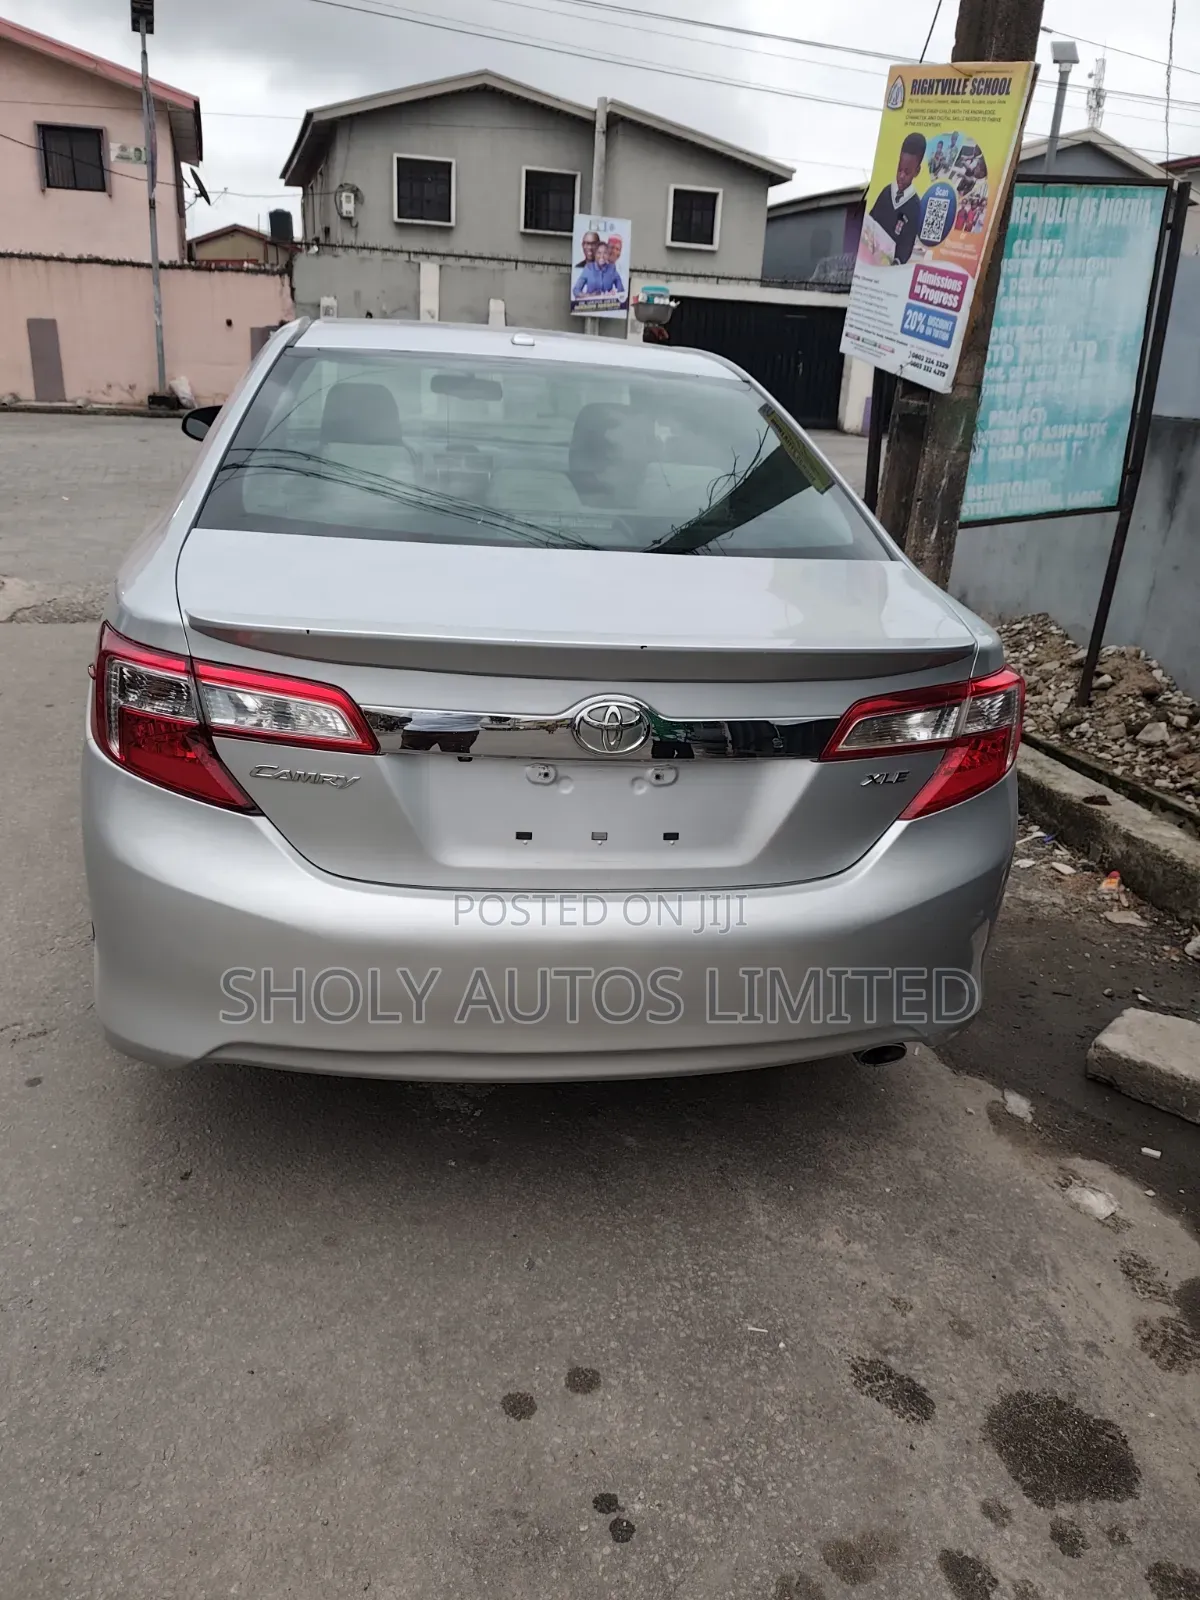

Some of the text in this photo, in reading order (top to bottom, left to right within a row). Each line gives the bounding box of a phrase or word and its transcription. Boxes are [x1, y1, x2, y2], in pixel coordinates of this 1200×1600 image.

[910, 77, 1013, 96] RIGHTVILLE SCHOOL
[1010, 196, 1152, 225] REPUBLIC OF NIGERIA
[917, 270, 963, 292] Admissions
[920, 285, 960, 308] Progress
[904, 308, 927, 334] 20%
[250, 764, 361, 789] CAMRY
[860, 770, 910, 787] XLE
